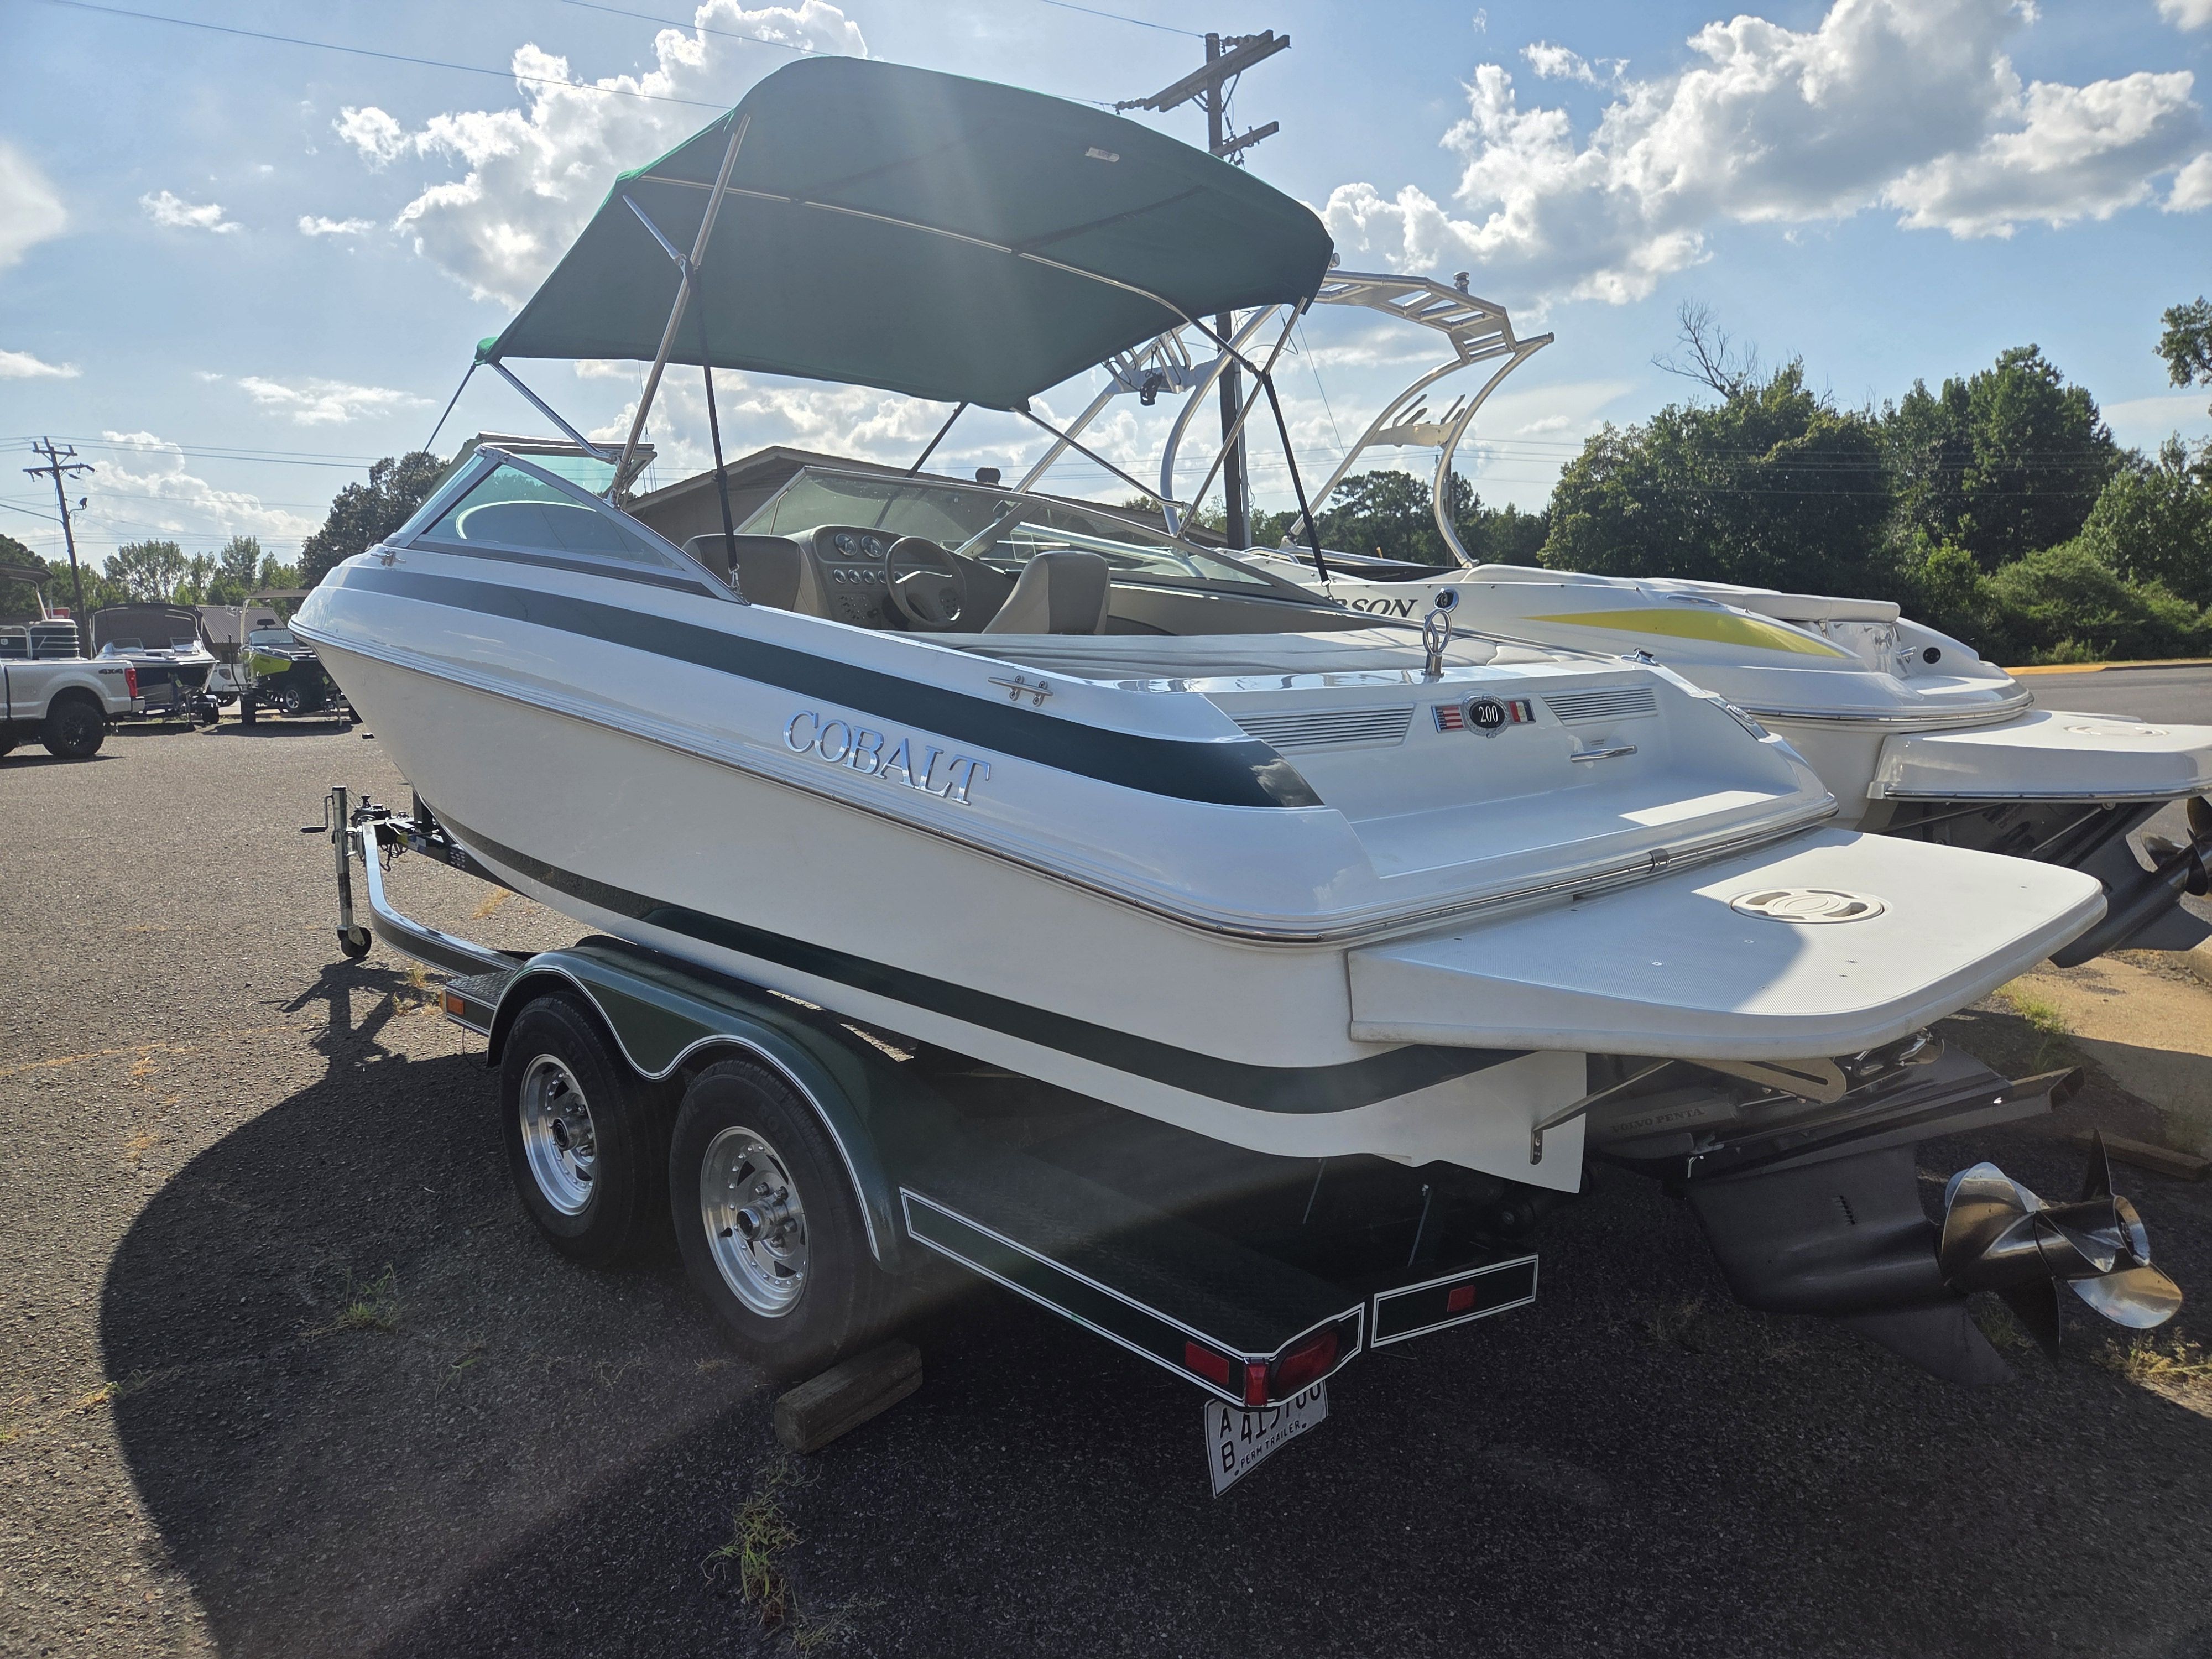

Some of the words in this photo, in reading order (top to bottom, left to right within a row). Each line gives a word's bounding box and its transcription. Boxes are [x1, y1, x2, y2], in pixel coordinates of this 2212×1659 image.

[1479, 705, 1498, 722] 200
[782, 710, 991, 806] COBALT
[1610, 1118, 1653, 1133] VOLVO
[1656, 1108, 1705, 1124] PENTA
[1240, 1446, 1262, 1469] PERM
[1265, 1420, 1300, 1450] TRAILER
